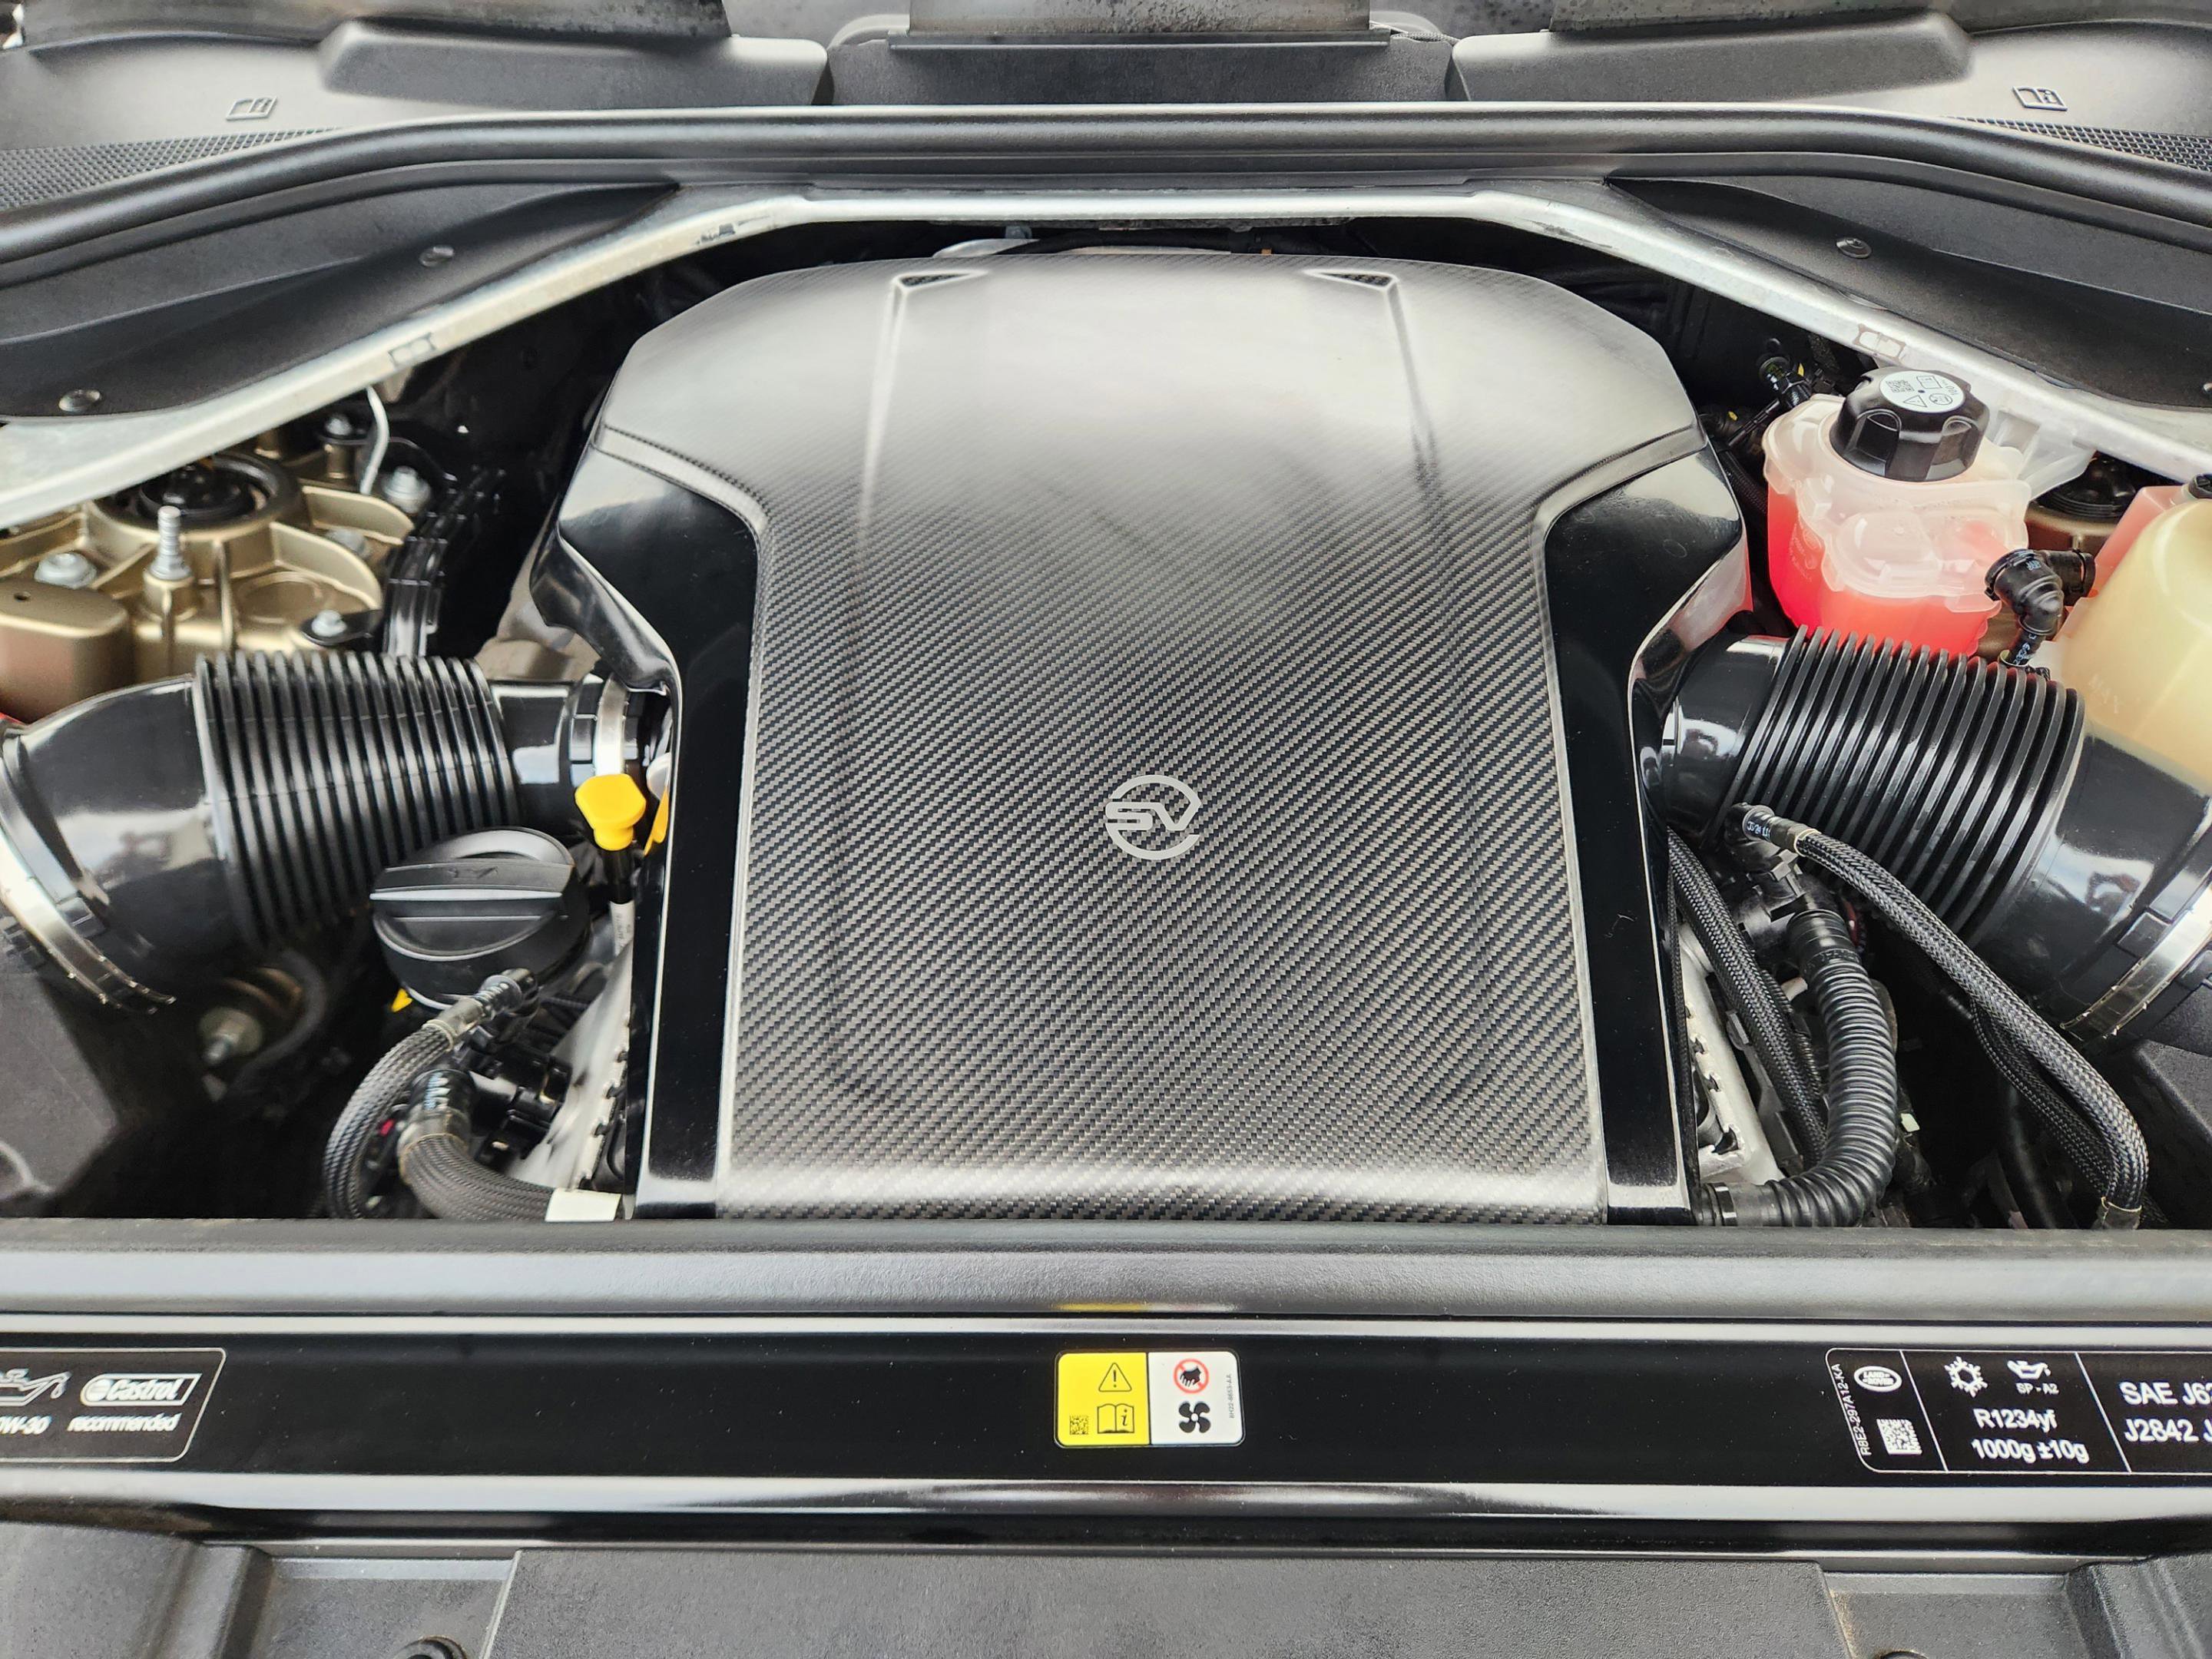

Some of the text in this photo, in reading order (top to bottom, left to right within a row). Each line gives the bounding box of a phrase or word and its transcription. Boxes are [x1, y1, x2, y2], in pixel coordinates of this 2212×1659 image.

[106, 1378, 184, 1401] Castrol
[1868, 1377, 1894, 1386] ROVER
[2119, 1381, 2178, 1405] SAE
[66, 1412, 182, 1432] recommended
[1973, 1409, 2058, 1433] R1234yf
[2124, 1419, 2200, 1442] J2842
[1971, 1439, 2090, 1464] 1000g ±10g
